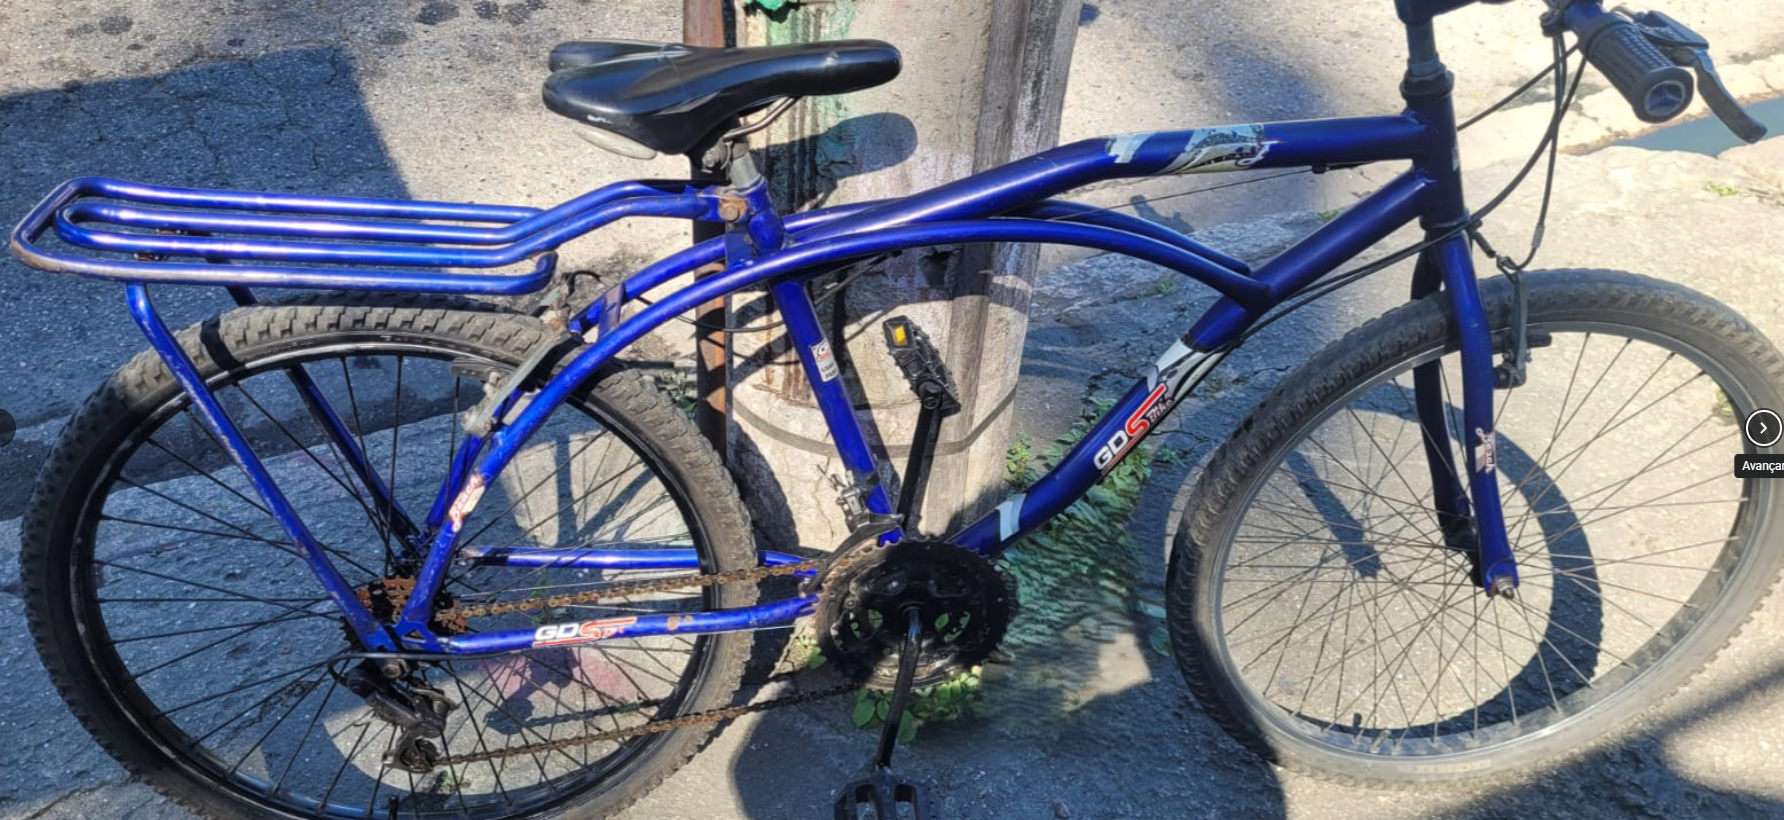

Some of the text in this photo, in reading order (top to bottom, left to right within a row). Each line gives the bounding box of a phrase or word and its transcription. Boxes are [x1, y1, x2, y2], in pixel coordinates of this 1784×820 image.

[1093, 383, 1174, 470] GDS Bike
[534, 616, 637, 642] GDS
